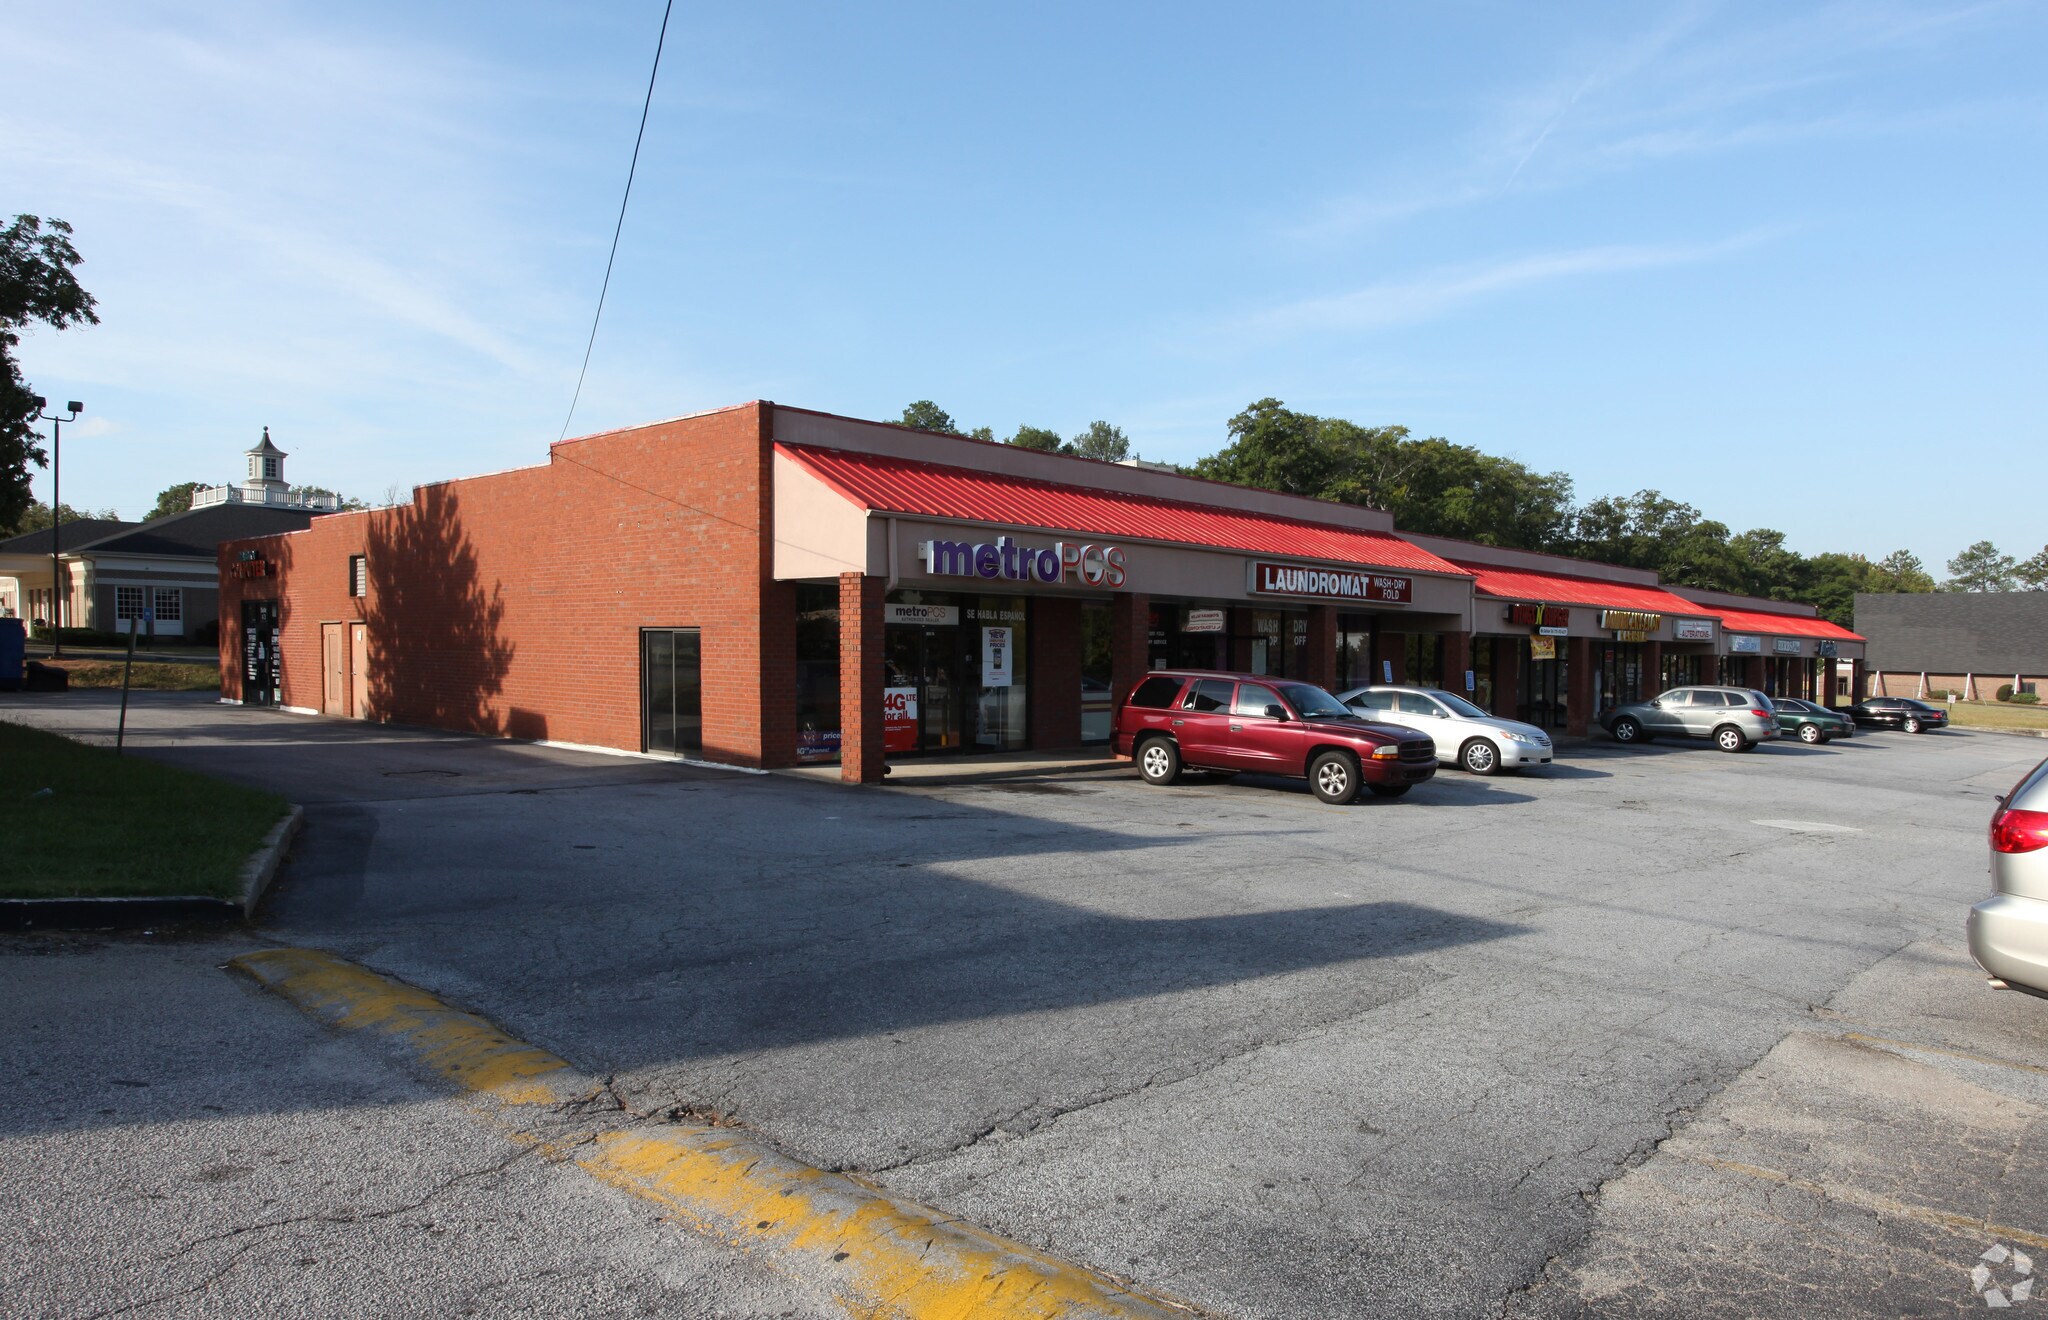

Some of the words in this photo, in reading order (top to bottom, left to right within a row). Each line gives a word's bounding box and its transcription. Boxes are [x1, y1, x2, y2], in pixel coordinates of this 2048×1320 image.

[926, 536, 1127, 588] metroPCS
[1264, 567, 1369, 597] LAUNDROMAT
[1382, 588, 1400, 600] FOLD
[895, 606, 946, 618] metroPCS
[966, 609, 975, 619] SE
[977, 610, 998, 620] HABLA
[1257, 619, 1278, 633] WASH
[1293, 619, 1308, 633] DRY
[1293, 635, 1307, 646] OFF
[884, 692, 906, 711] 4G
